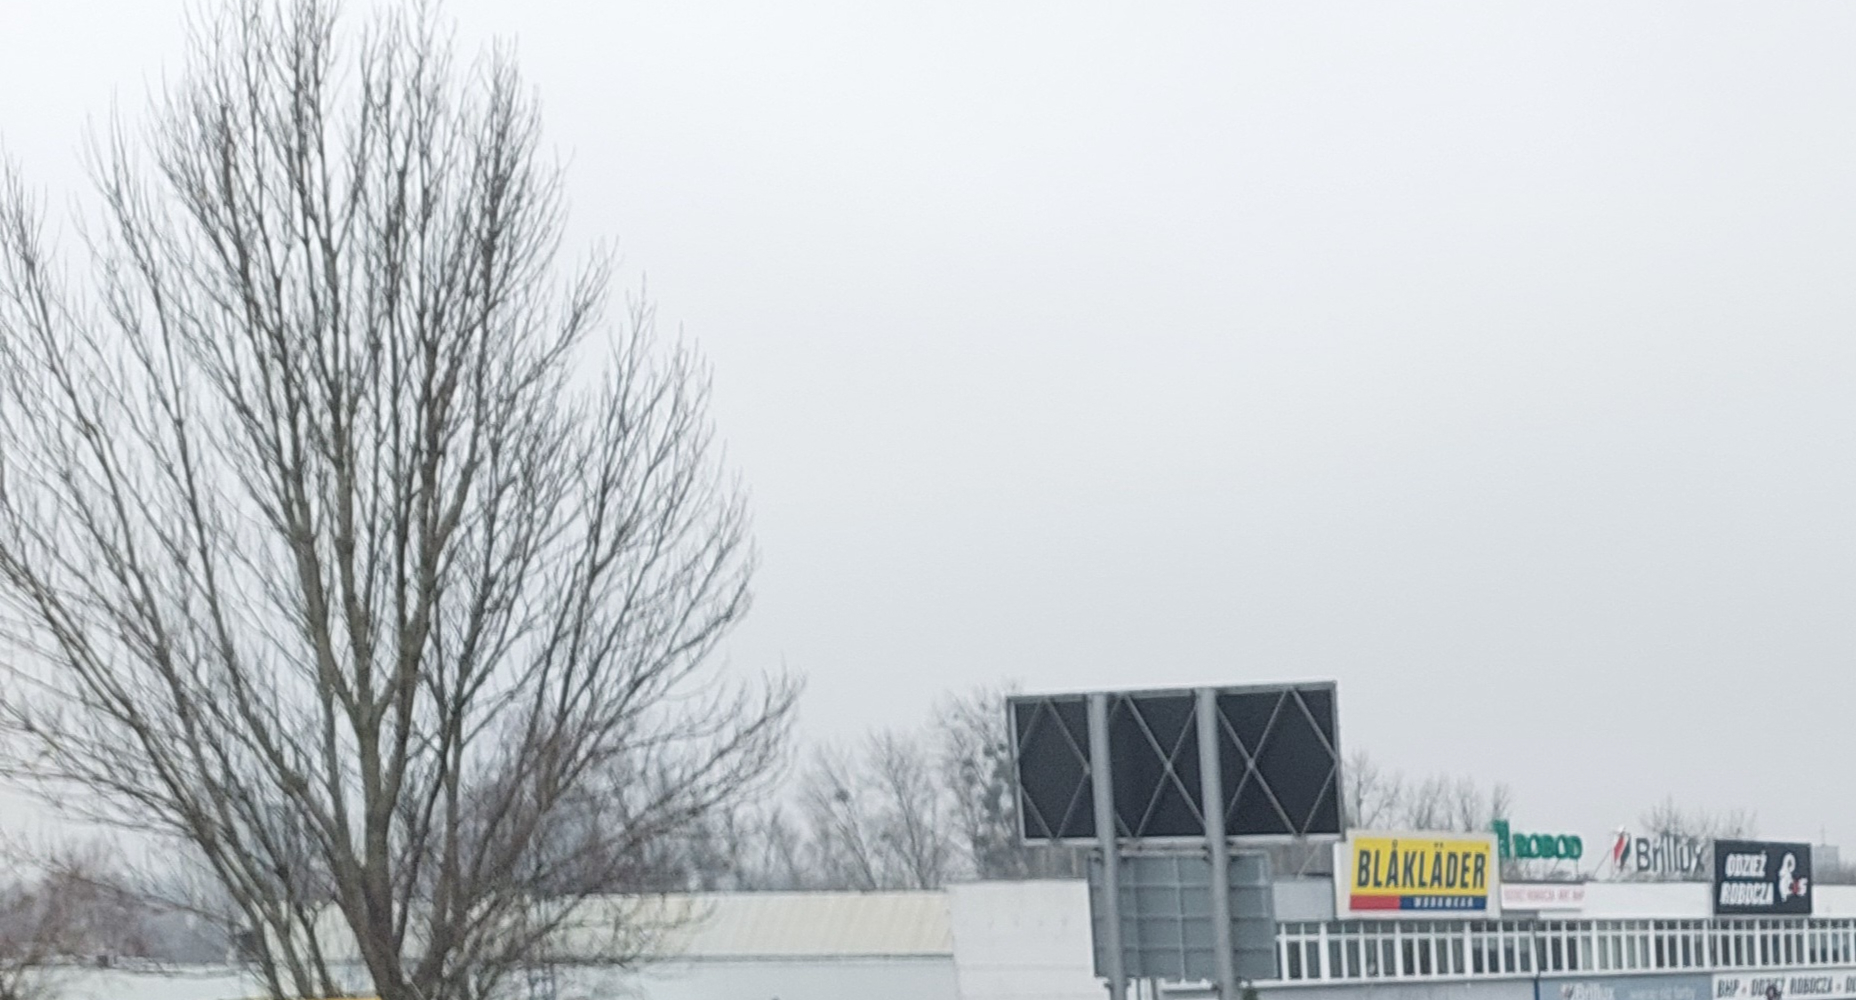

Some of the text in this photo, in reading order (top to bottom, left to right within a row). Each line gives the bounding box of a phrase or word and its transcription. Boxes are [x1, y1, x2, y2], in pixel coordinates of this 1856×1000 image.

[1357, 839, 1486, 888] BLÅKLÄDER
[1636, 834, 1704, 872] Brillux
[1719, 881, 1774, 905] ROBOCZA
[1717, 978, 1740, 998] BHP
